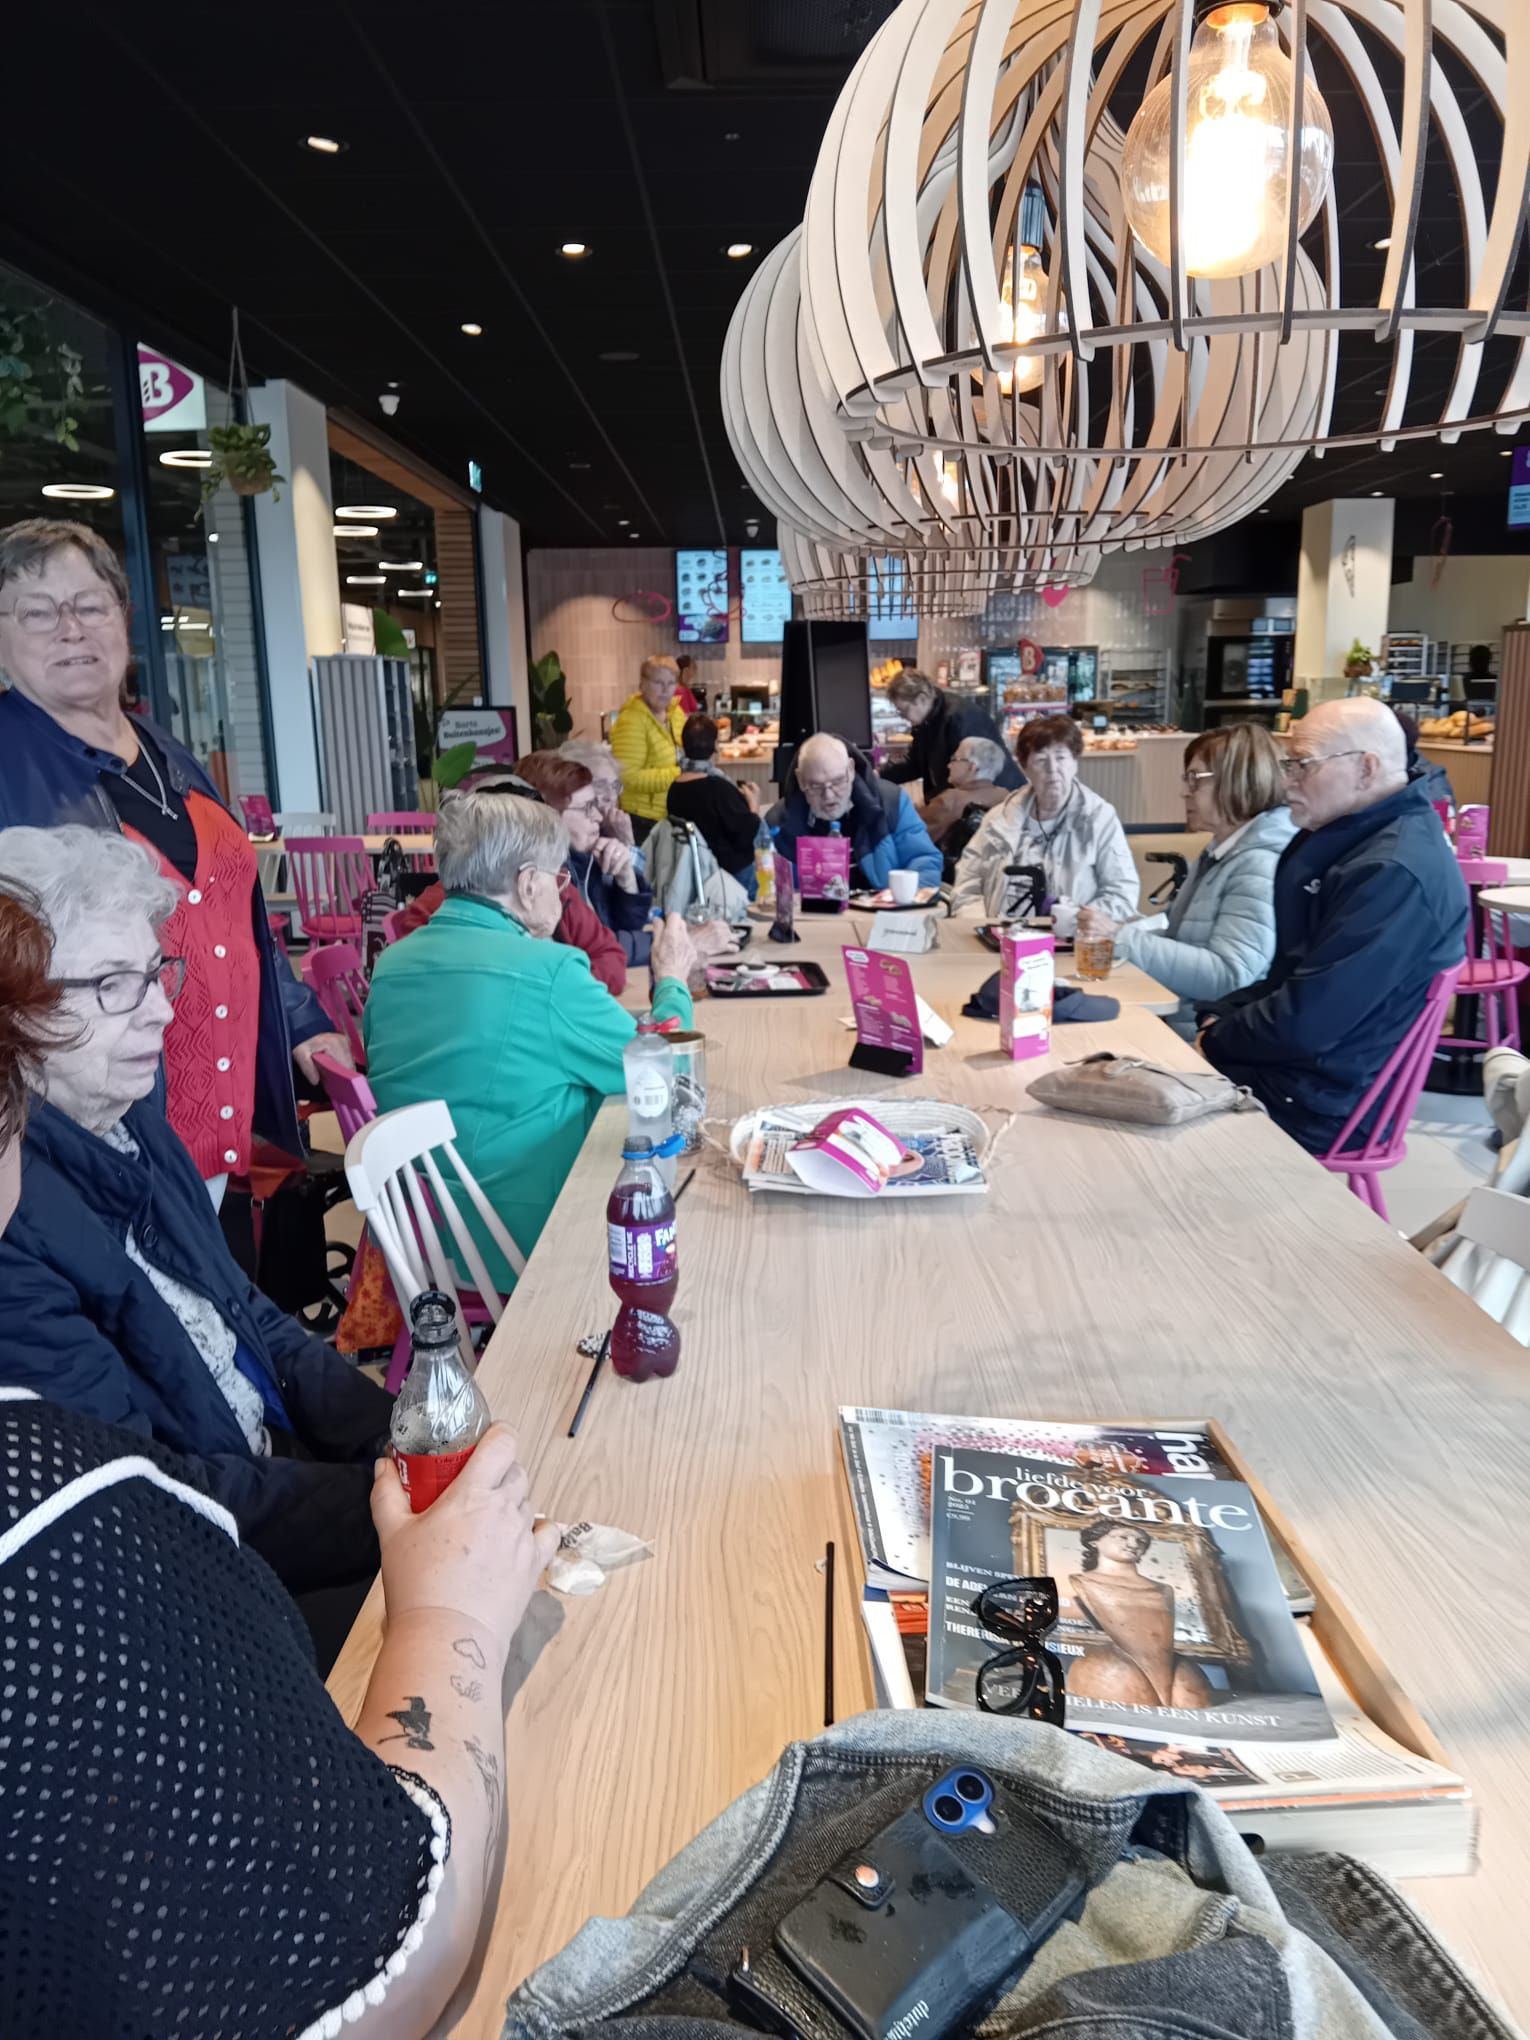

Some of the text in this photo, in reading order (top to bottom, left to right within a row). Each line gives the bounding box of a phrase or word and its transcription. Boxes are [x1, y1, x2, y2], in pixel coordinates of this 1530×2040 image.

[138, 362, 174, 408] B
[1022, 646, 1036, 671] B
[939, 1455, 1253, 1531] brocante
[1015, 1466, 1147, 1499] liefde voor
[945, 1561, 993, 1577] BLIJVEN
[945, 1576, 960, 1588] DE
[962, 1580, 988, 1593] ADE
[1133, 1704, 1152, 1715] IS
[1156, 1706, 1199, 1721] EEN
[1204, 1711, 1281, 1728] KUNST
